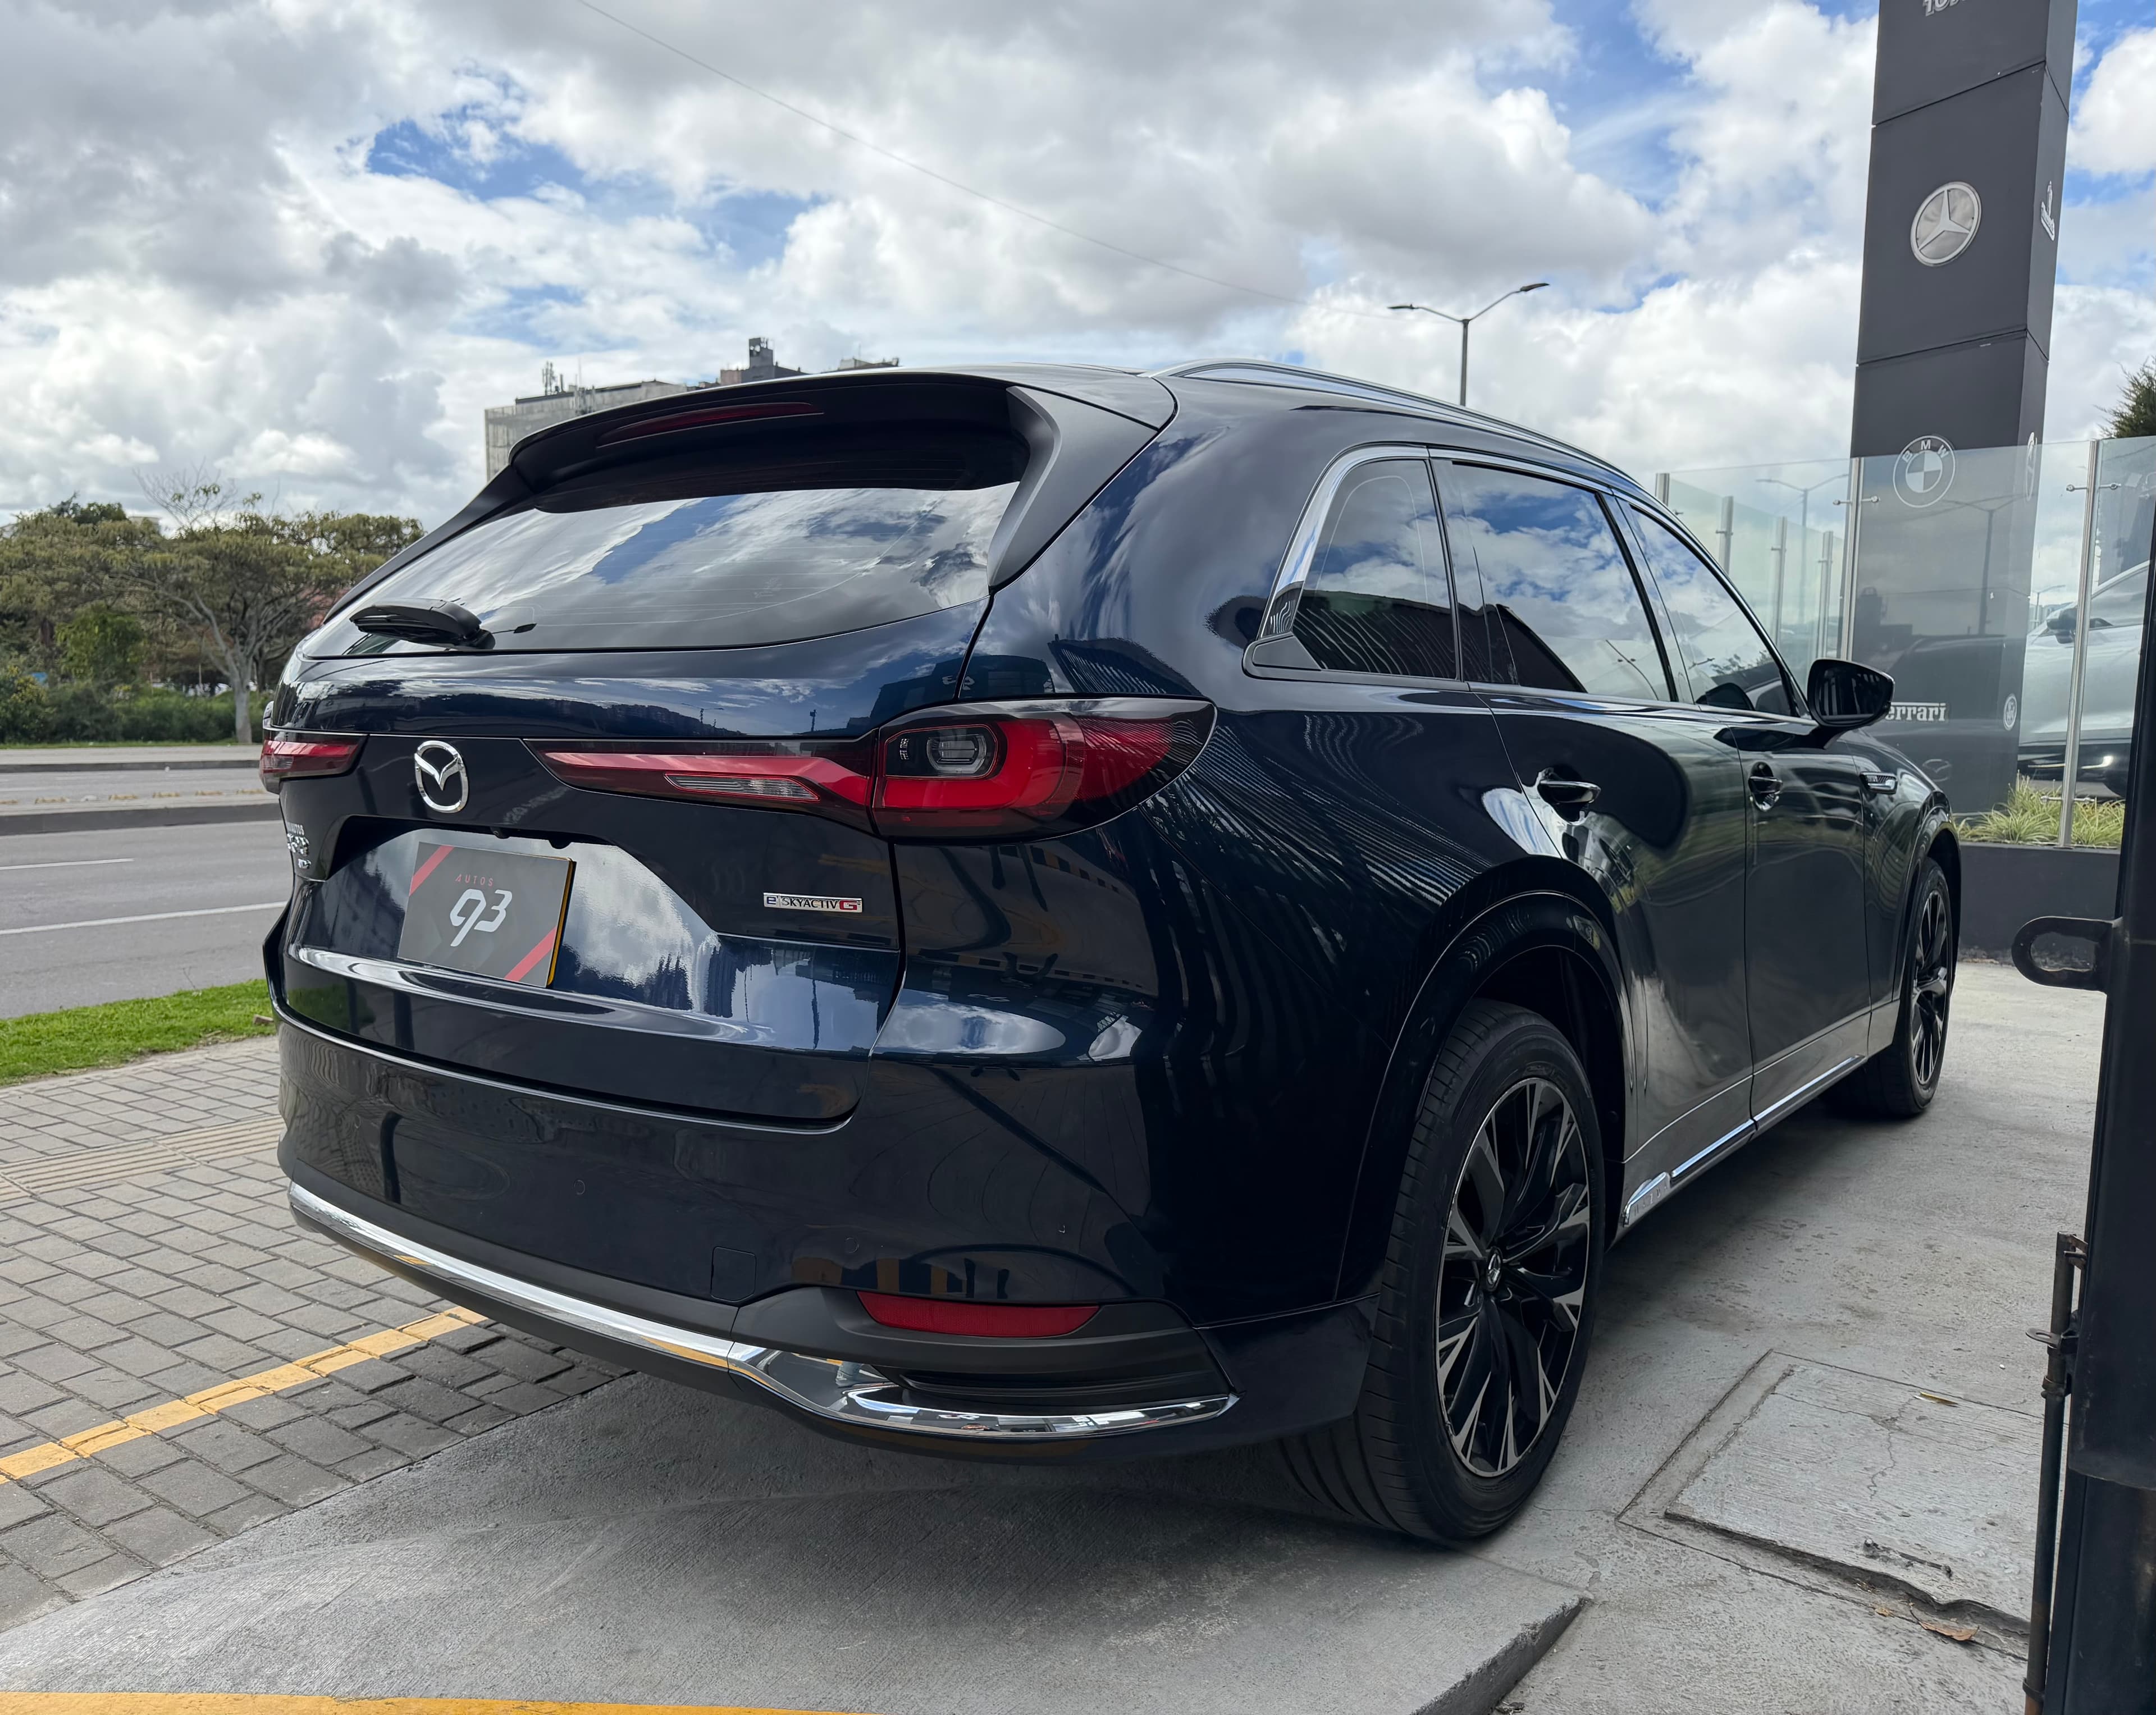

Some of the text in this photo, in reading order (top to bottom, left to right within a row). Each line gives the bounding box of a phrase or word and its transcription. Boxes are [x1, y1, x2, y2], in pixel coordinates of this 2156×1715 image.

[1902, 440, 1949, 463] BMW
[1885, 702, 1946, 721] errari
[455, 874, 494, 887] AUTOS
[450, 889, 513, 947] 93
